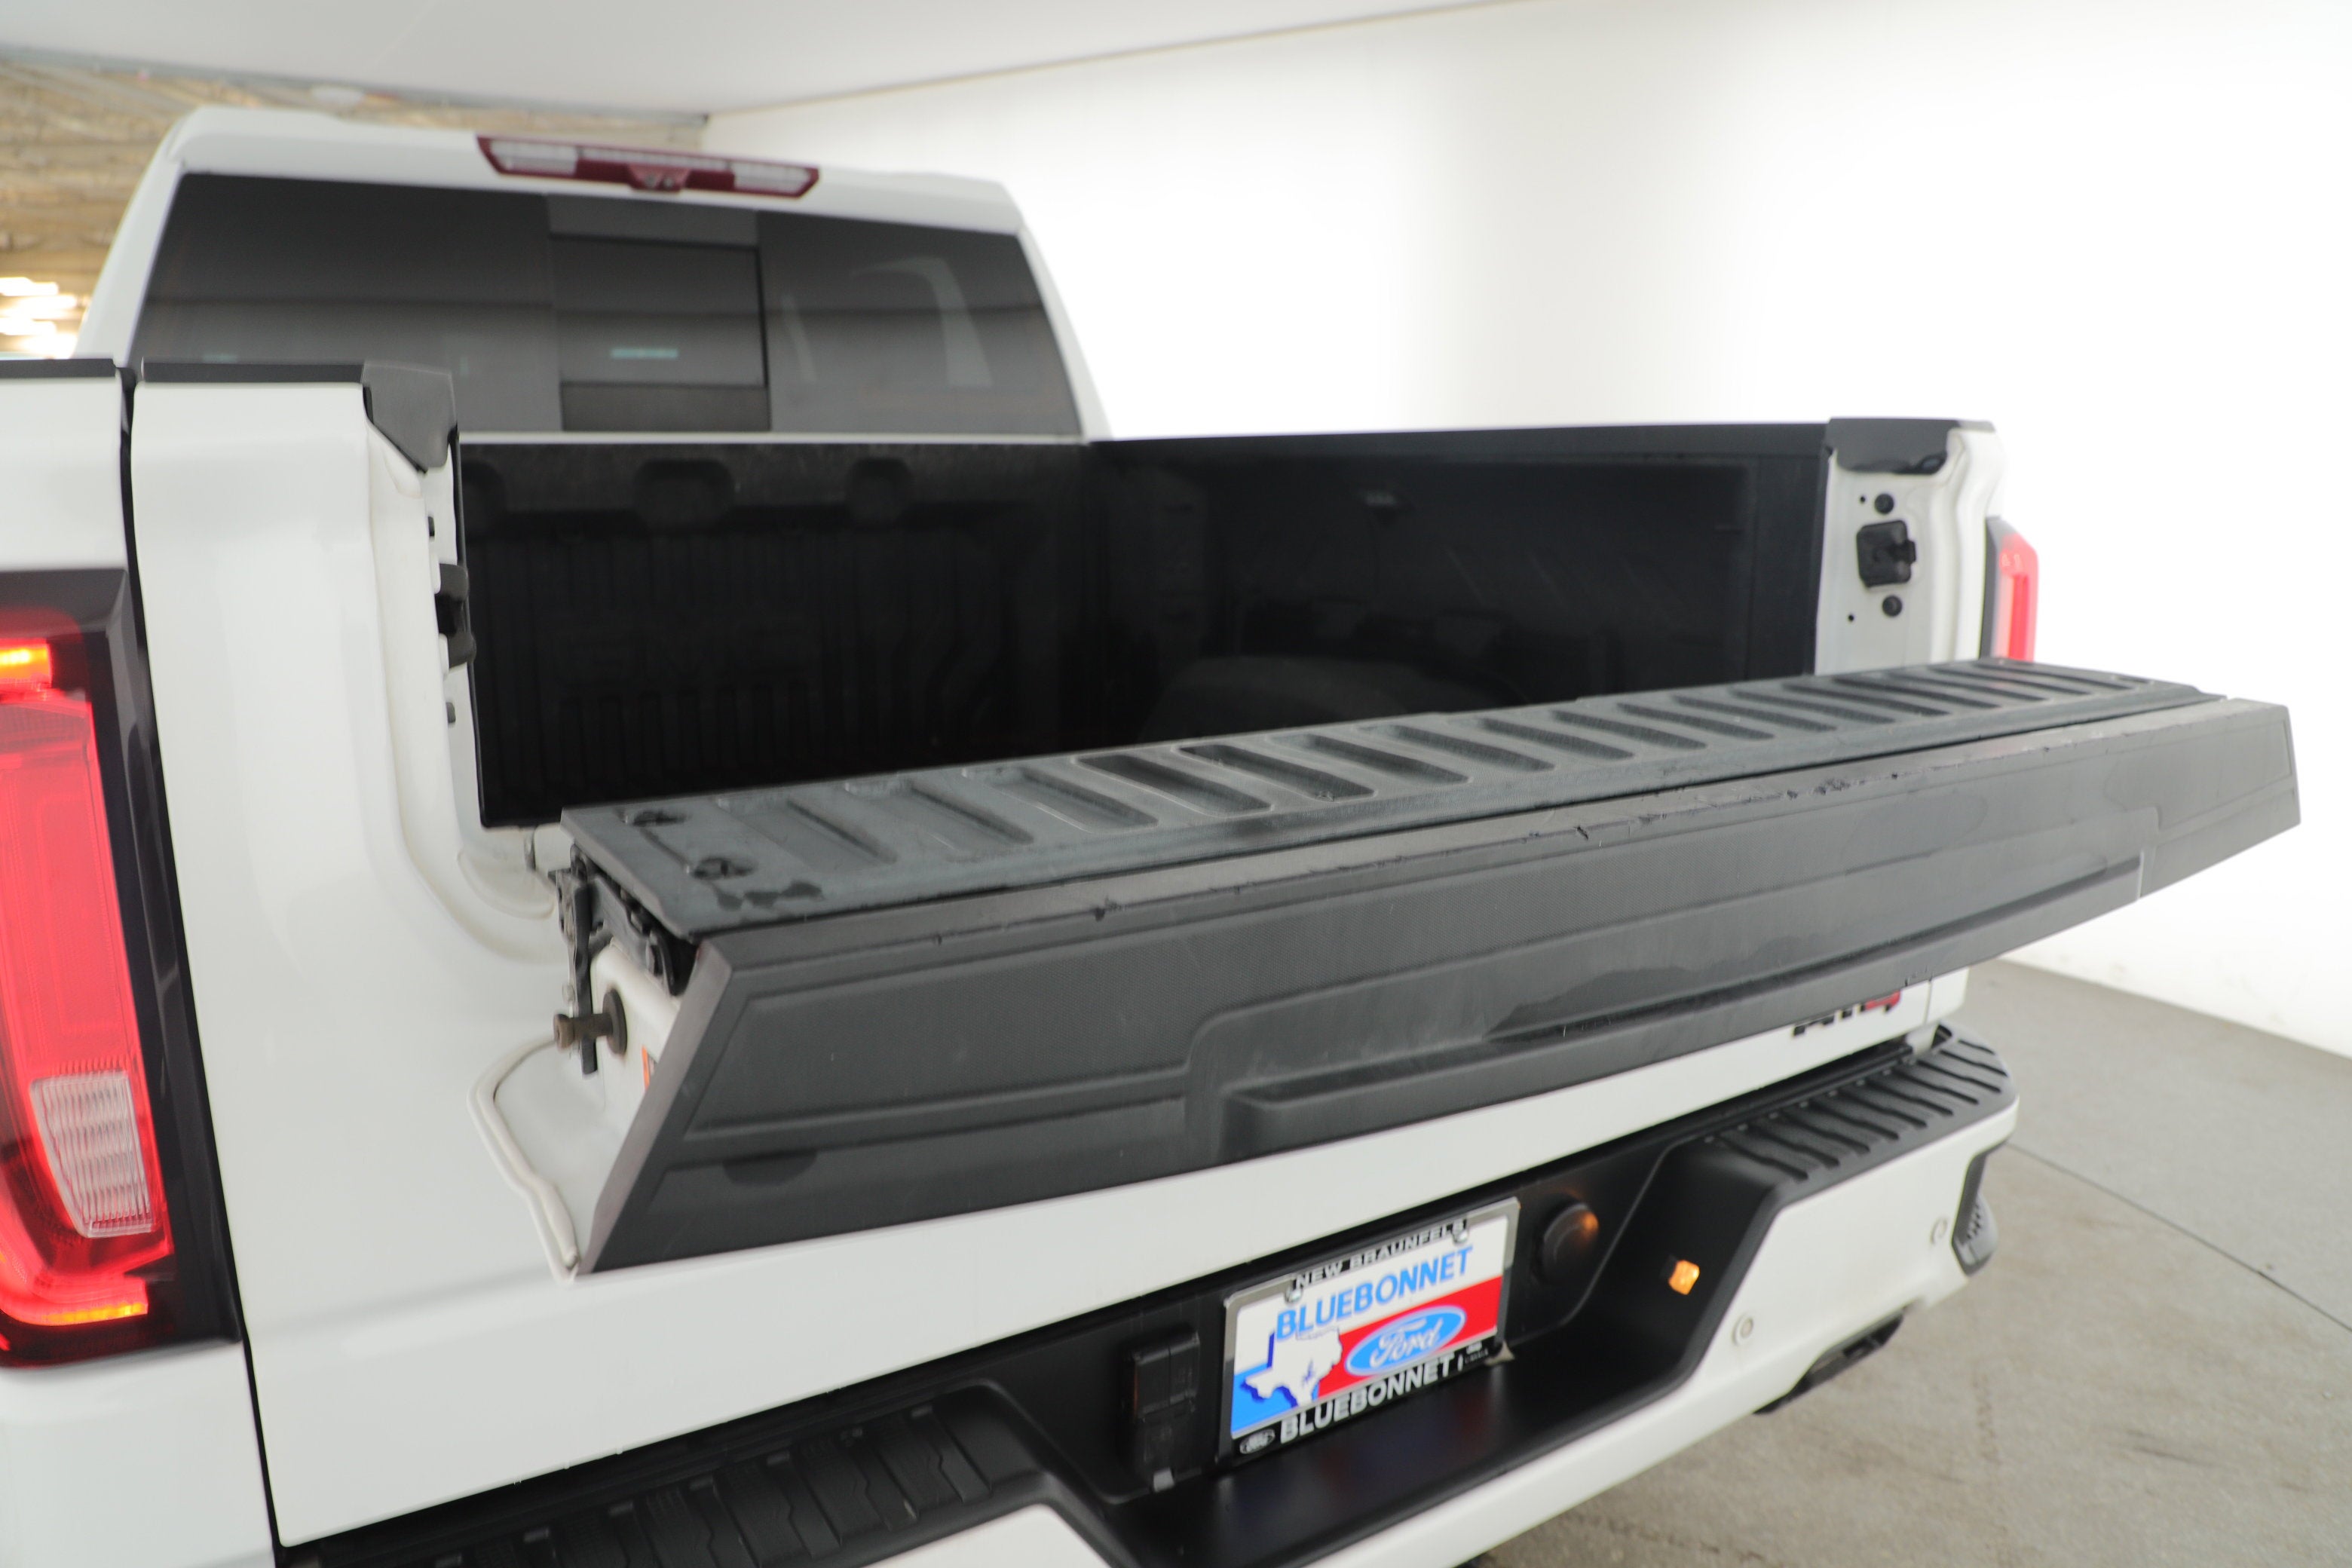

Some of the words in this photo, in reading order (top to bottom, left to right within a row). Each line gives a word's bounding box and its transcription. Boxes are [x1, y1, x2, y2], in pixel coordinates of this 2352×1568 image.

[1276, 1245, 1474, 1343] BLUEBONNET
[1294, 1261, 1343, 1290] NEW
[1369, 1317, 1445, 1369] Ford
[1280, 1351, 1456, 1444] BLUEBONNET
